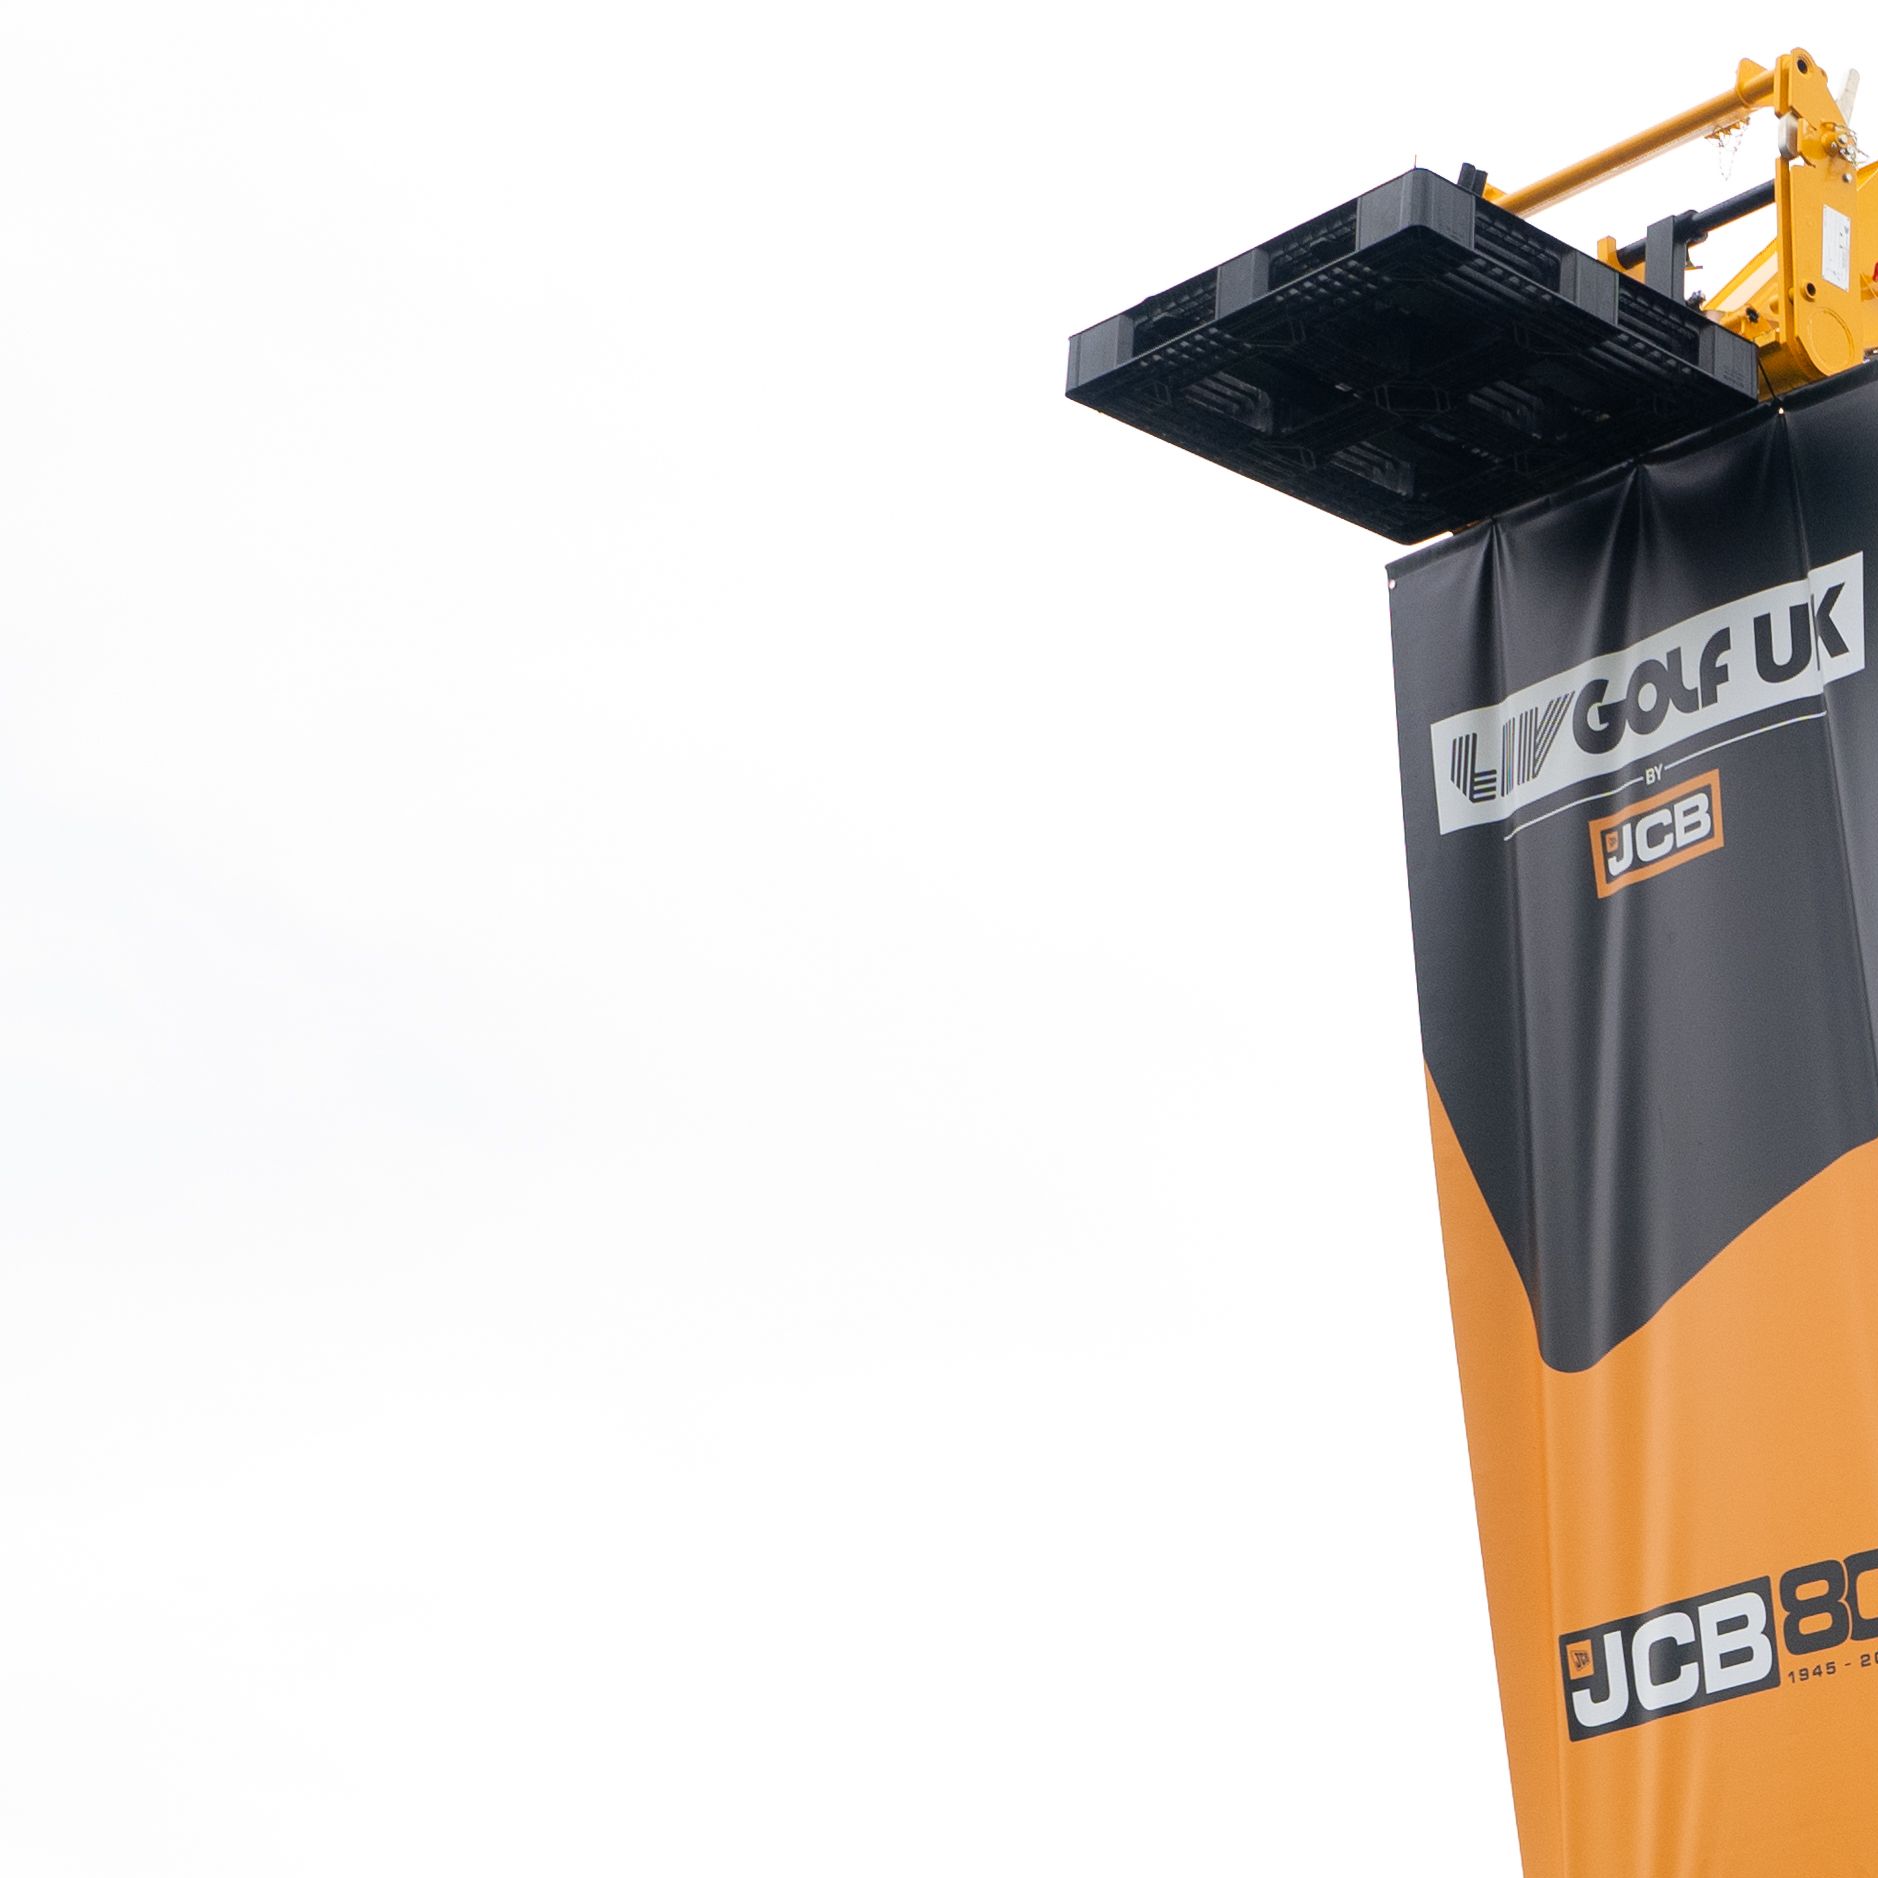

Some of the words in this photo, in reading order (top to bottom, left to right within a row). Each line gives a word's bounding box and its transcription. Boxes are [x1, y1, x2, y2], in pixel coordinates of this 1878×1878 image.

[1450, 690, 1576, 804] LIV
[1572, 627, 1732, 755] GOLF
[1753, 581, 1850, 685] UK
[1645, 766, 1665, 786] BY
[1606, 792, 1713, 878] JCB
[1787, 1661, 1837, 1684] 1945
